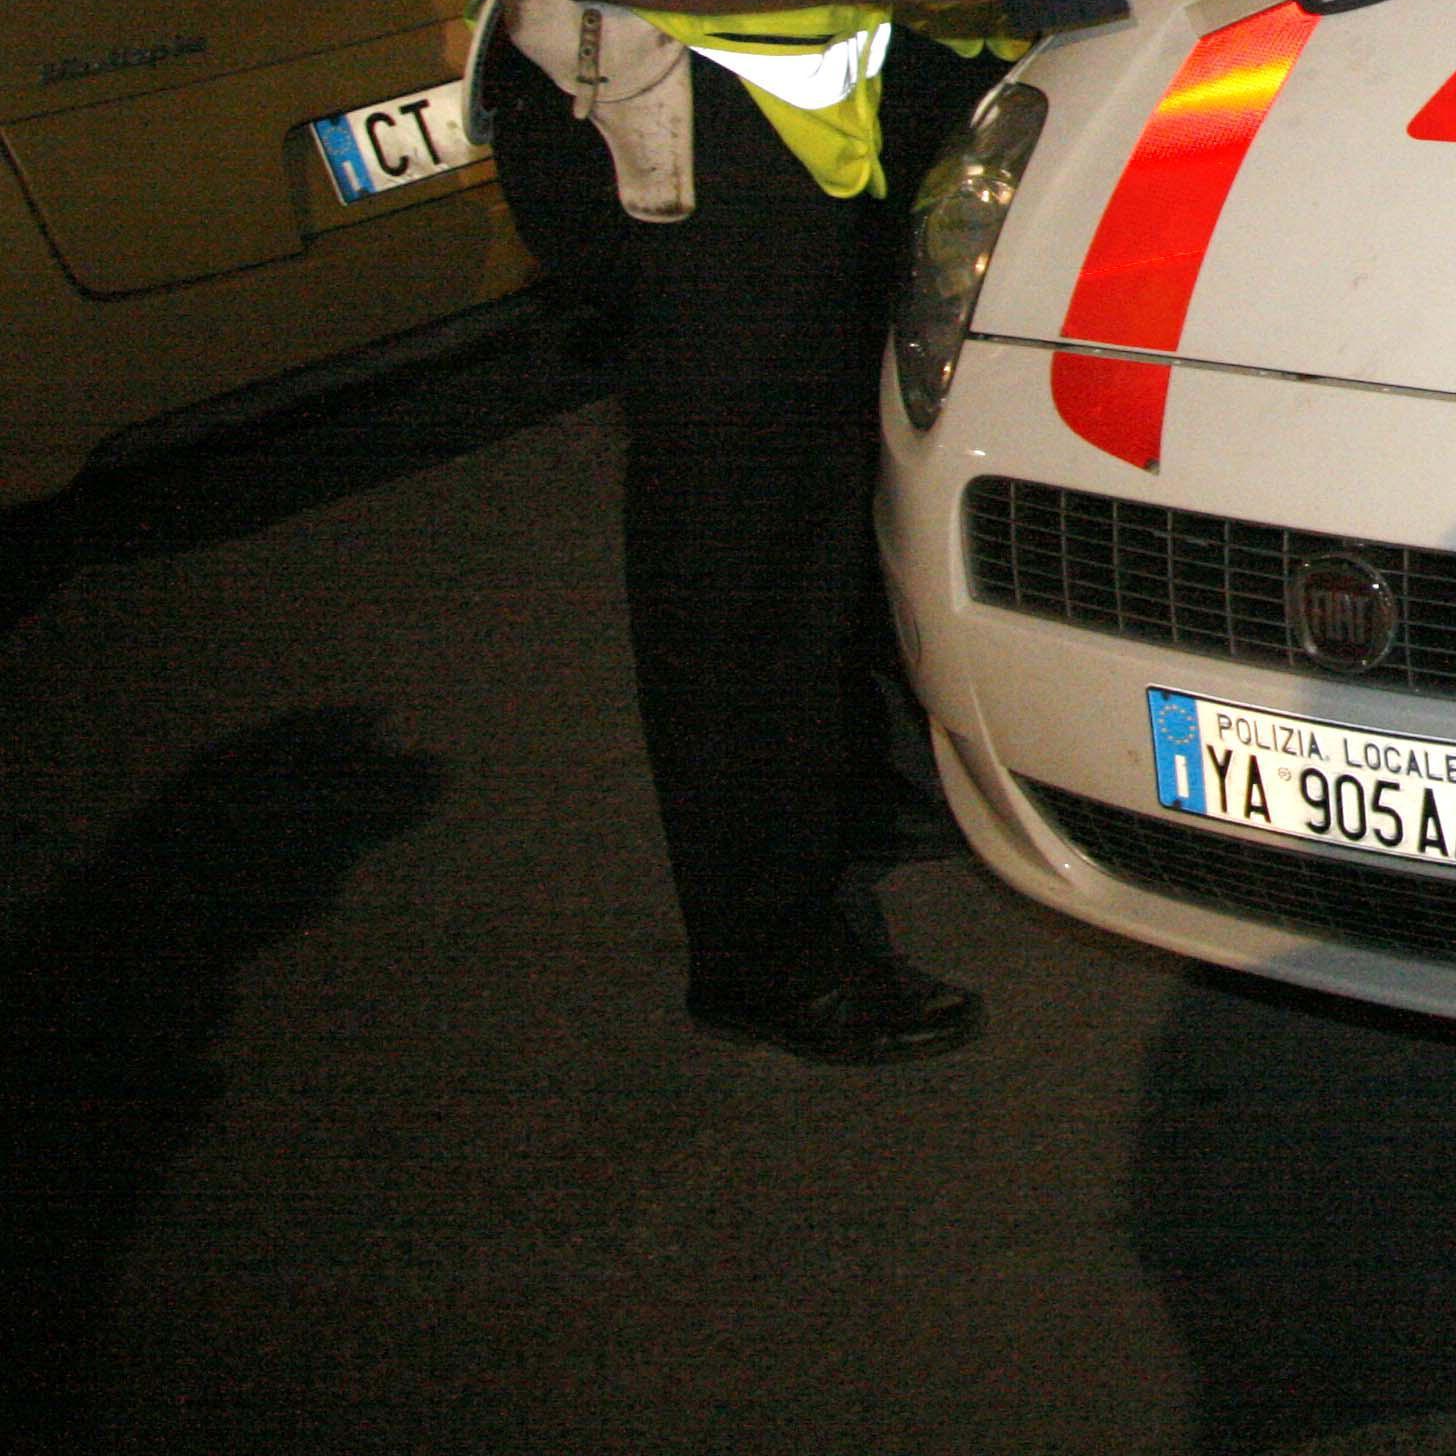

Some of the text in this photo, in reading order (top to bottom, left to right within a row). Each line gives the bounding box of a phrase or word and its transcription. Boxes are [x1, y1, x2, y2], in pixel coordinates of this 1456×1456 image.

[365, 99, 442, 176] CT
[1309, 589, 1376, 645] FIAT
[1216, 712, 1326, 761] POLIZIA
[1206, 743, 1273, 824] YA
